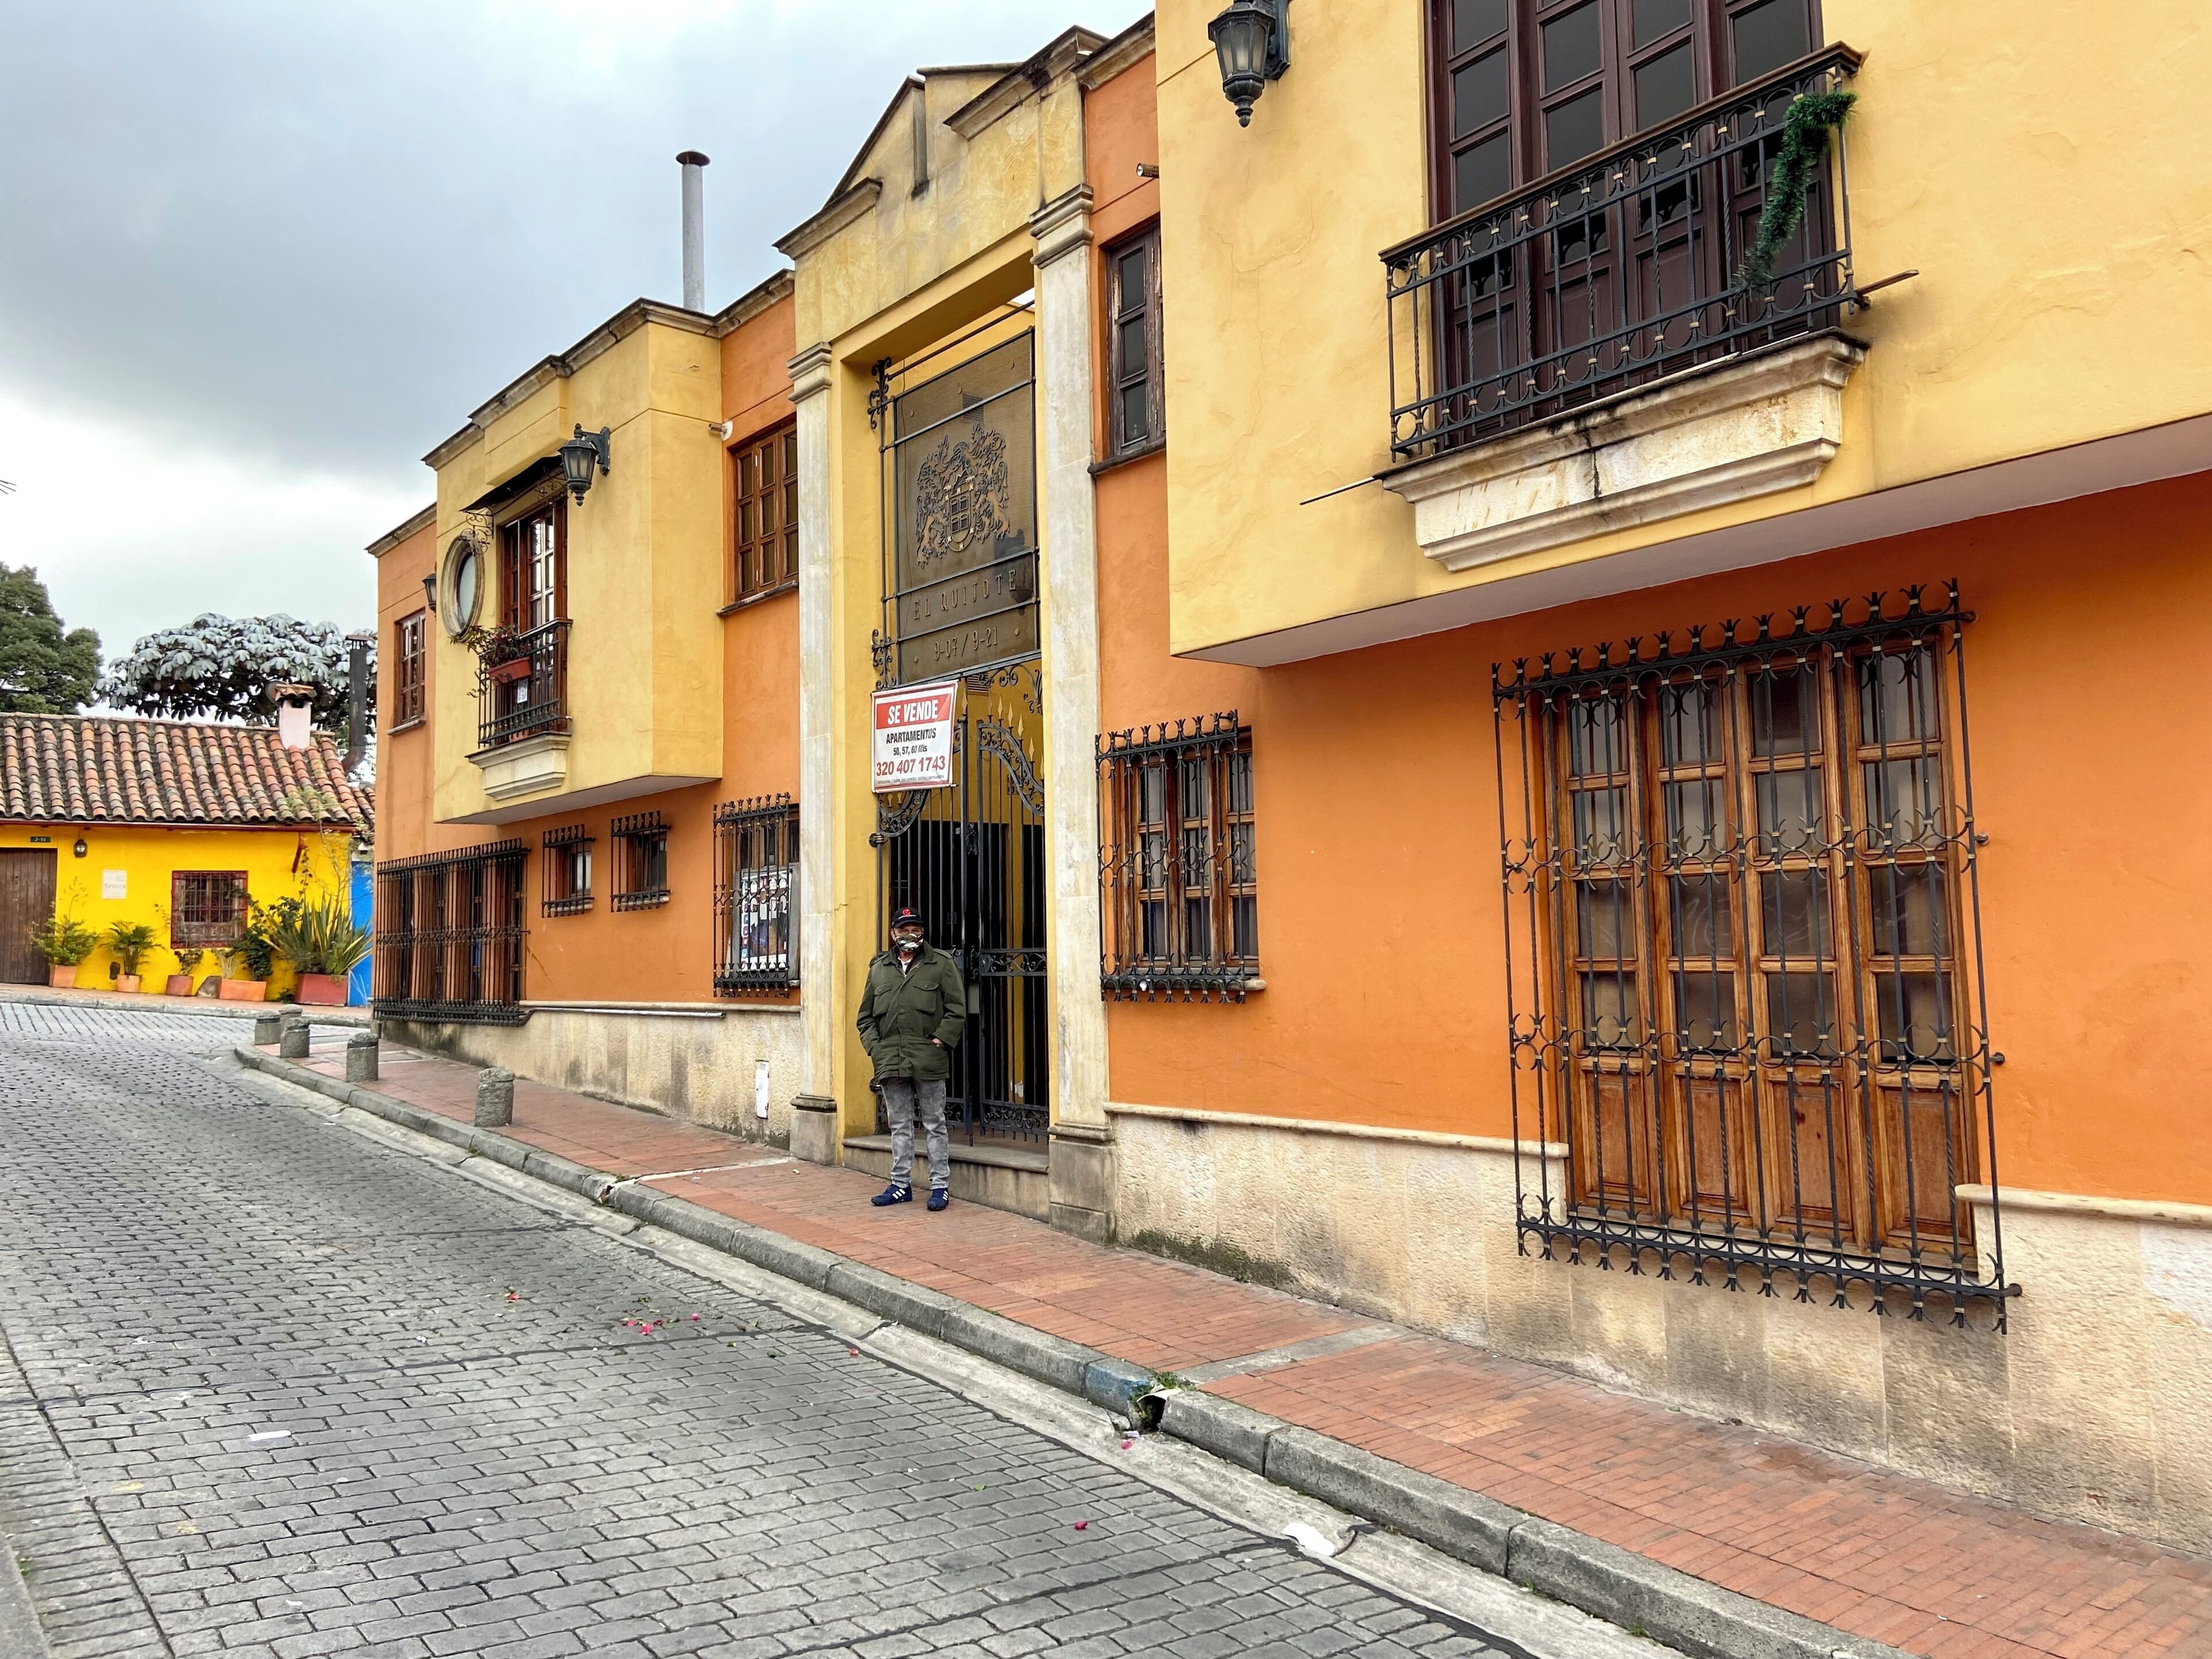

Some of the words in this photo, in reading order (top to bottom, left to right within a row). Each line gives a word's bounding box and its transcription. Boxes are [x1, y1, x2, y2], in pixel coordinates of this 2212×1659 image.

[914, 598, 931, 620] EL
[941, 569, 1016, 611] QUIJOTE
[888, 704, 902, 725] SE
[903, 699, 939, 722] VENDE
[886, 728, 937, 744] APARTAMENTOS
[911, 745, 918, 754] 60
[876, 761, 895, 777] 320
[896, 758, 916, 774] 407
[919, 755, 946, 772] 1743
